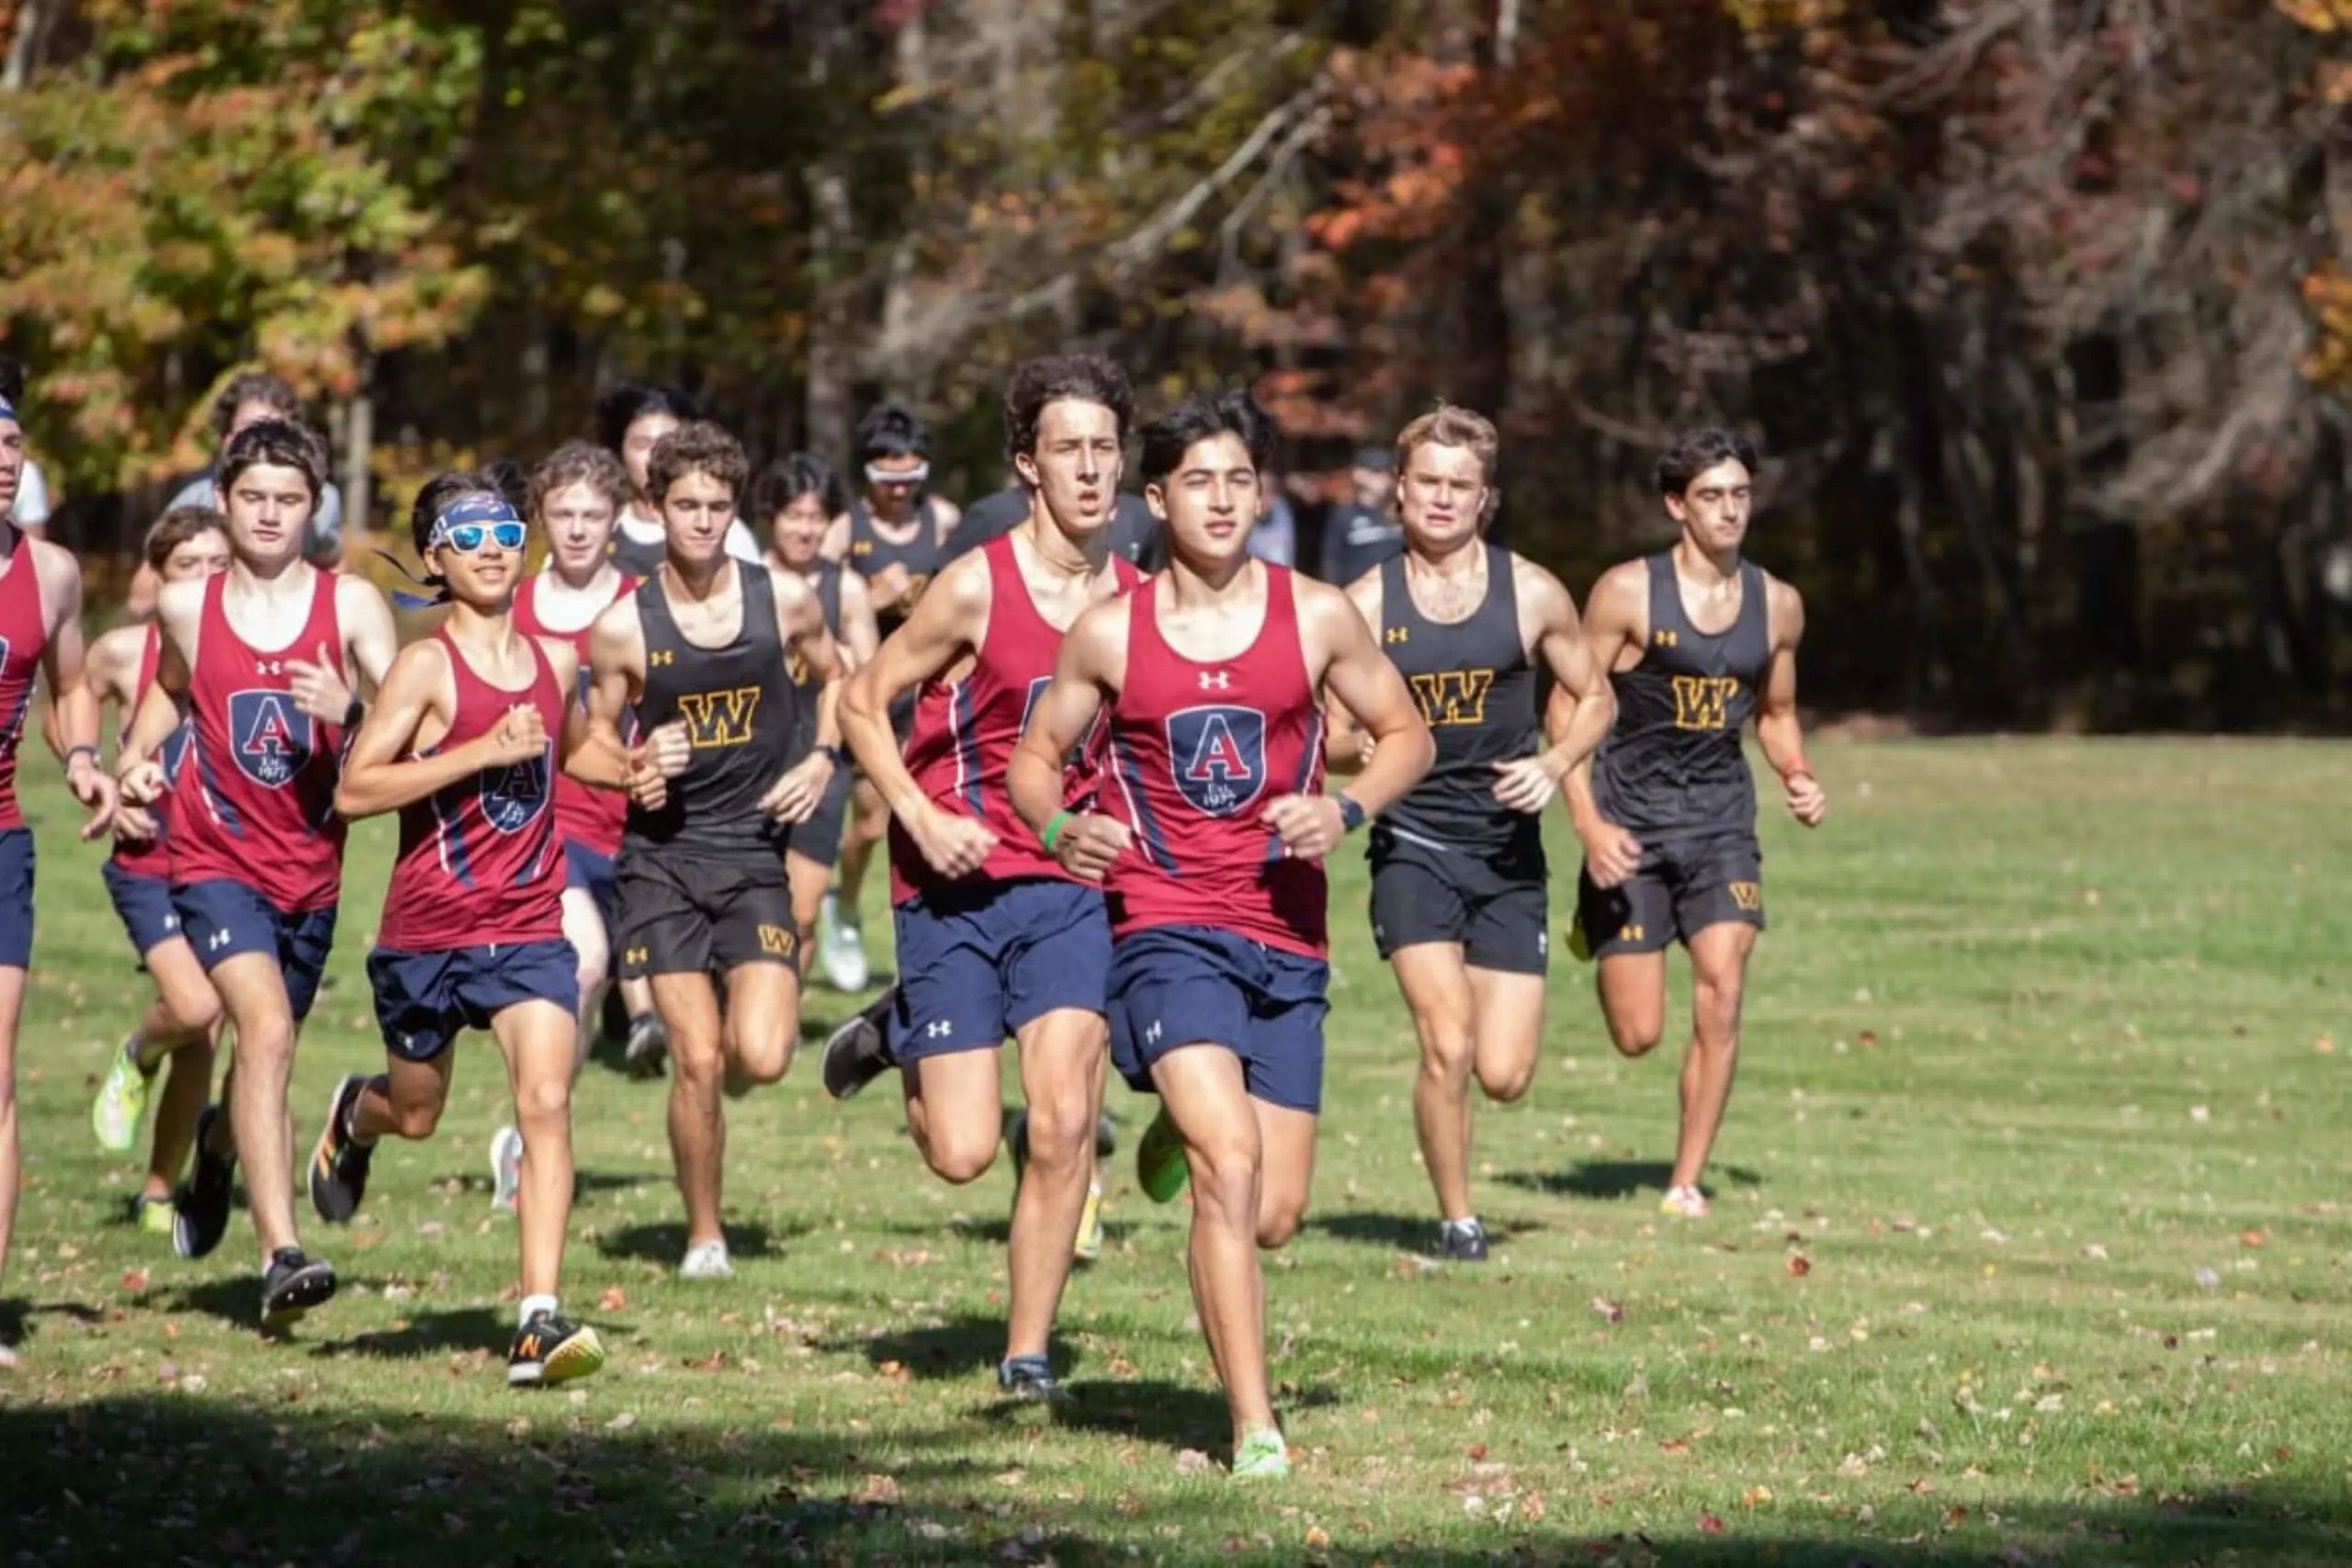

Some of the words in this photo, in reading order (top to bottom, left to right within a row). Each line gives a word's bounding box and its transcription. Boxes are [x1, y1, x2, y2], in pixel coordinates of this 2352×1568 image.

[243, 696, 296, 754] A
[678, 686, 761, 747] W
[1411, 670, 1494, 728] W
[1673, 676, 1738, 730] W
[1185, 713, 1251, 781] A
[758, 924, 795, 956] W
